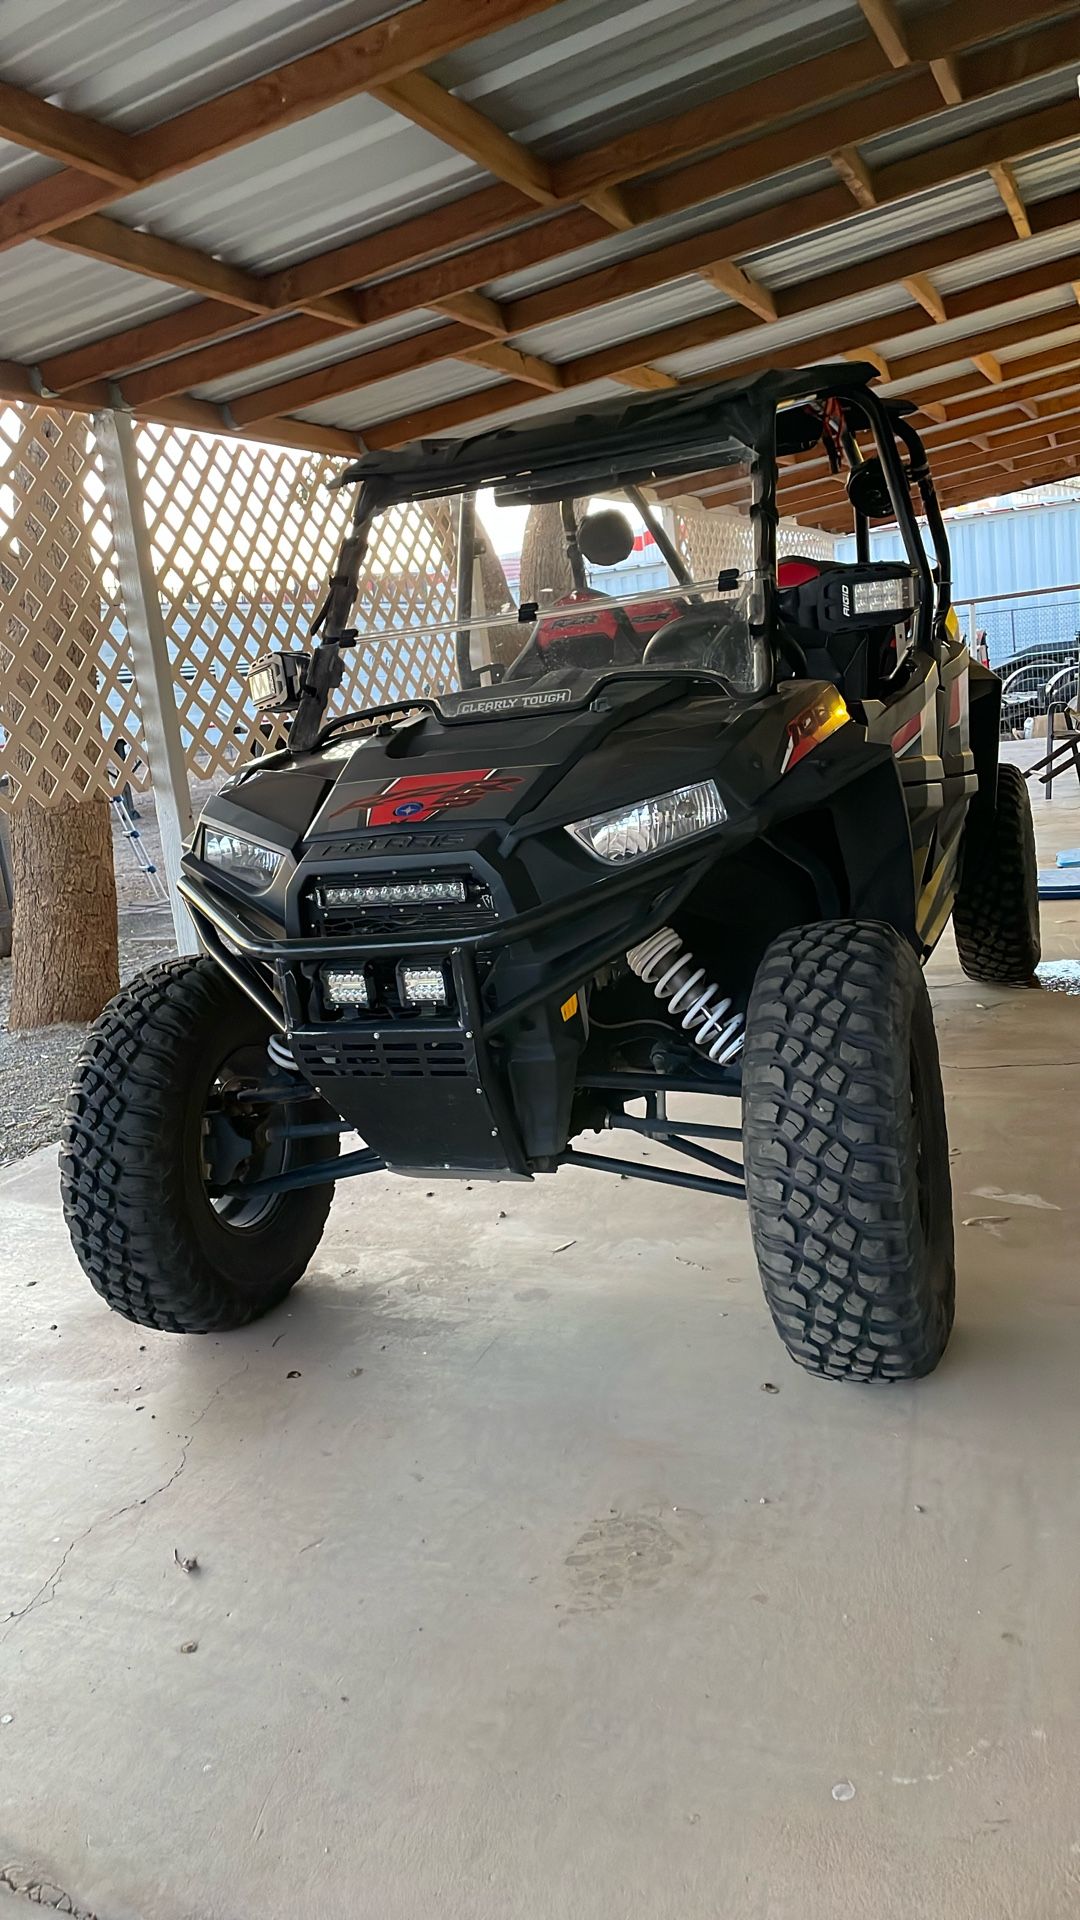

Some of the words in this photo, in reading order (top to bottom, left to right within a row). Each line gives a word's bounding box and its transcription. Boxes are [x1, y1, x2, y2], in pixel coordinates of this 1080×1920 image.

[841, 584, 851, 617] RIGID
[462, 699, 518, 713] CLEARLY
[522, 692, 567, 706] TOUGH
